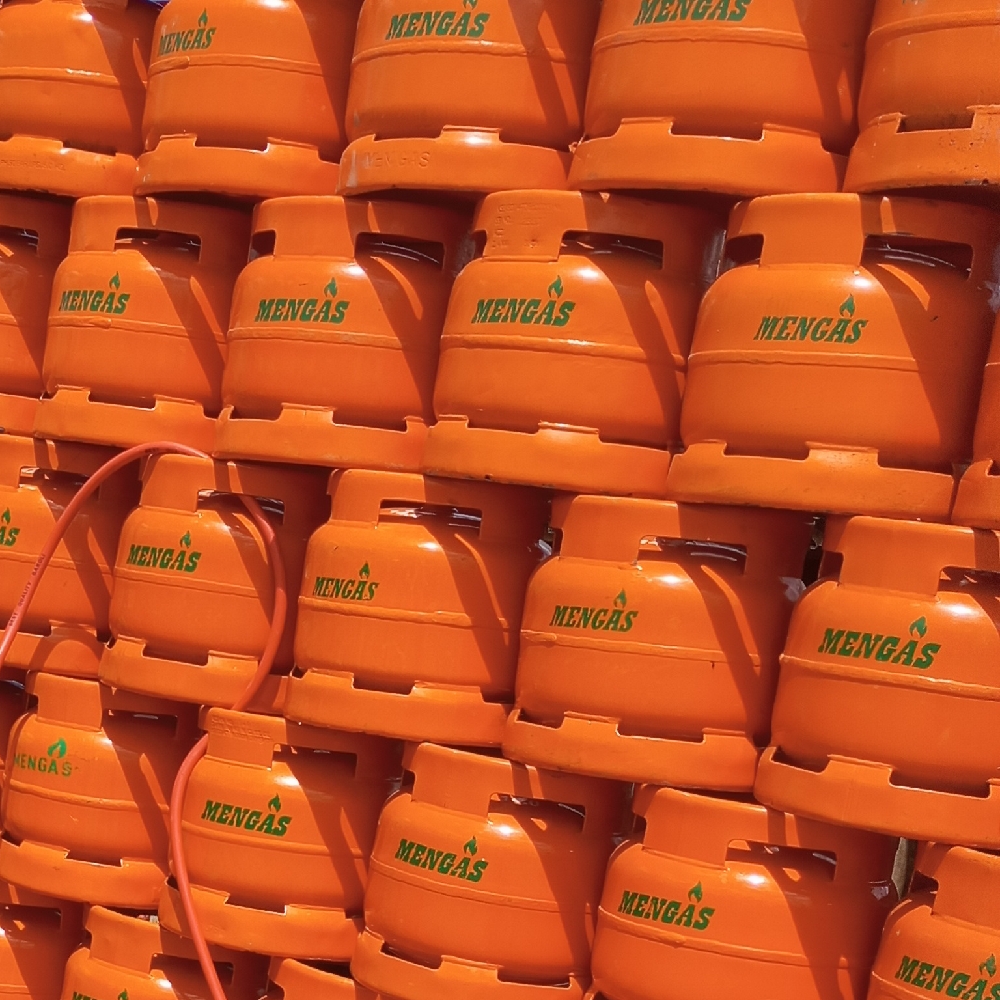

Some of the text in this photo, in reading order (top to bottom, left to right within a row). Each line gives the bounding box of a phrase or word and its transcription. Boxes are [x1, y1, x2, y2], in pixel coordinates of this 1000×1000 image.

[158, 26, 217, 55] MENGAS
[386, 14, 490, 38] MENGAS
[58, 289, 131, 315] MENGAS
[254, 299, 350, 325] MENGAS
[471, 298, 576, 328] MENGAS
[754, 314, 869, 346] MENGAS
[128, 544, 202, 573] MENGAS
[313, 575, 379, 601] MENGAS
[549, 604, 639, 633] MENGAS
[816, 627, 942, 670] MENGAS
[14, 755, 73, 778] MENGAS
[201, 799, 293, 838] MENGAS
[393, 838, 488, 884] MENGAS
[616, 890, 716, 932] MENGAS
